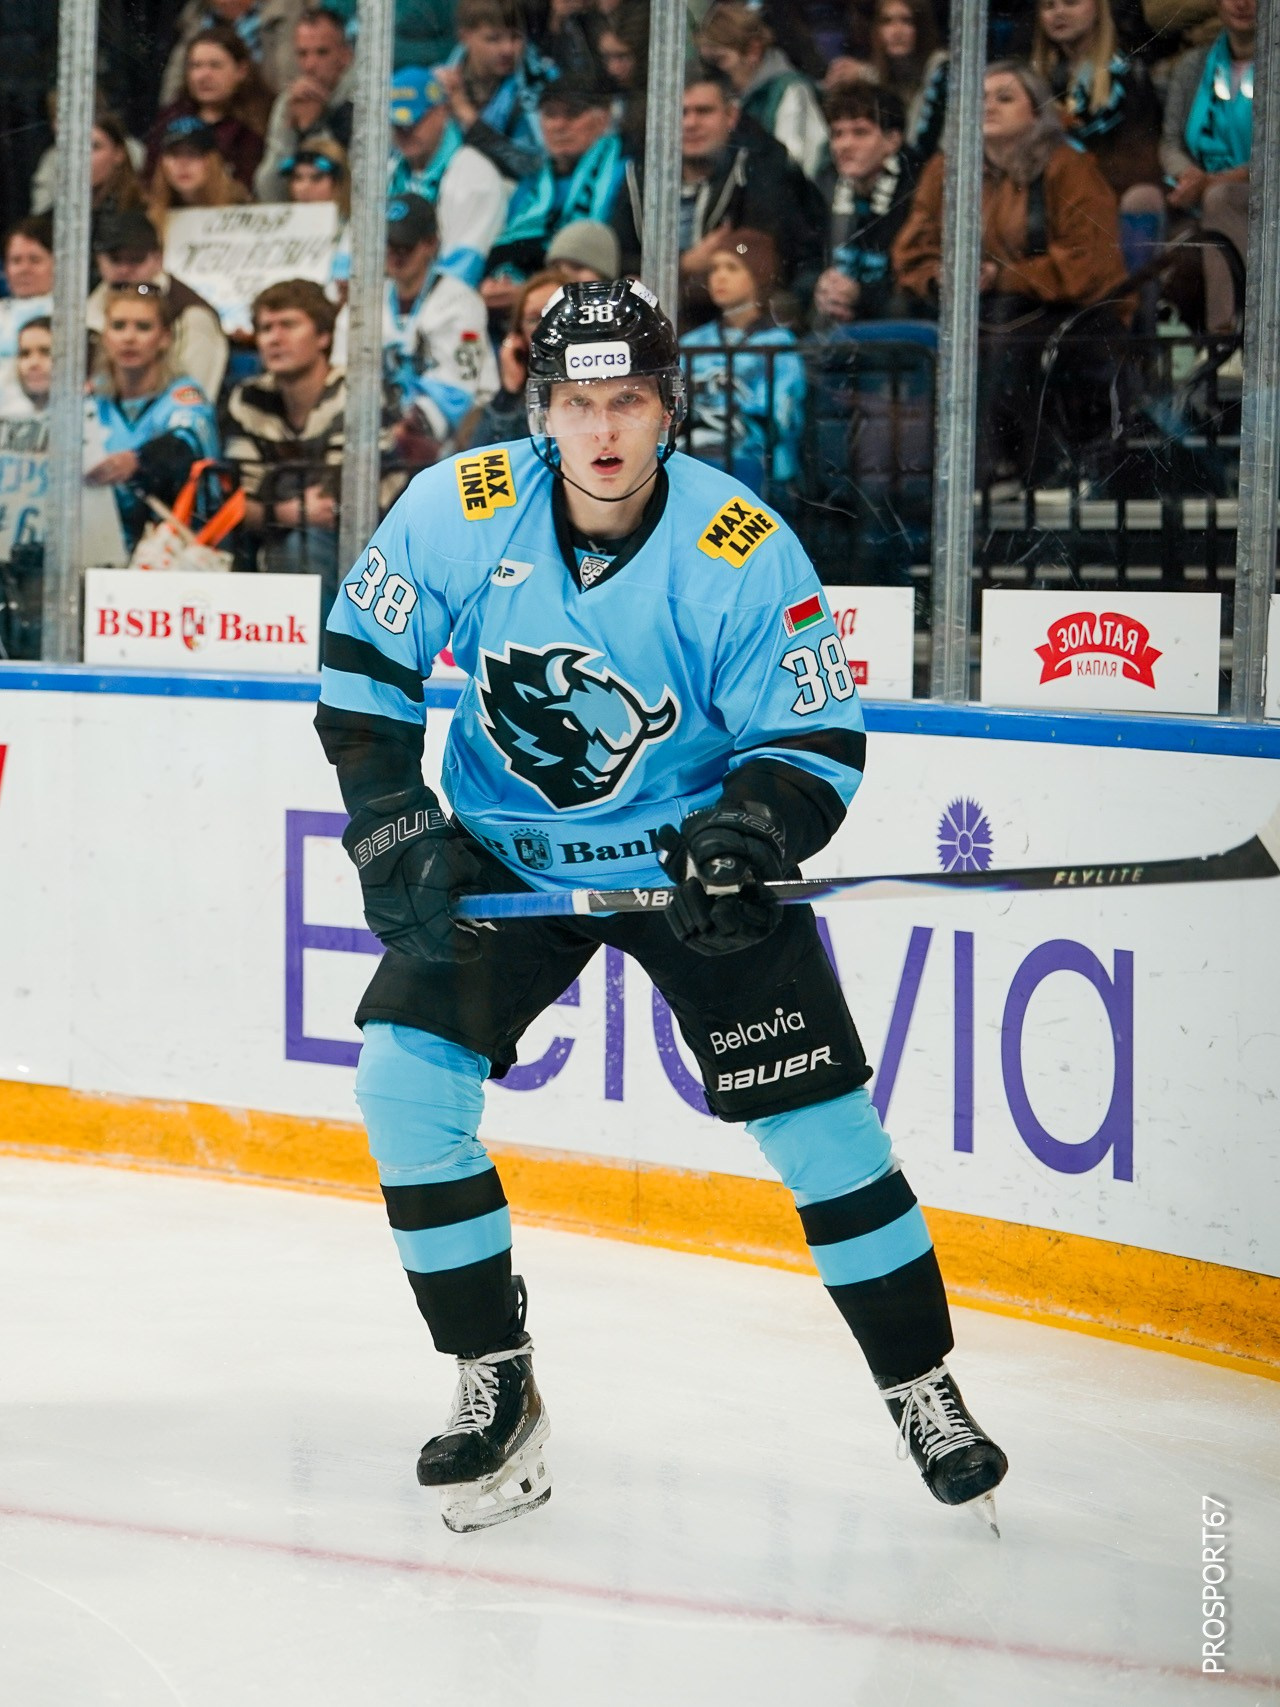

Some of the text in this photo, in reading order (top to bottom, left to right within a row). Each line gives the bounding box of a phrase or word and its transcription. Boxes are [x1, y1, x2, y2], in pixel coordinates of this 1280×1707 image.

[578, 304, 614, 324] 38
[460, 463, 487, 510] LINE
[483, 454, 510, 498] MAX
[705, 502, 752, 549] MAX
[728, 513, 773, 557] LINE
[344, 546, 419, 635] 38
[97, 607, 308, 644] BSB Bank
[1056, 620, 1139, 656] ЗОЛОТАЯ
[779, 633, 856, 717] 38
[1076, 659, 1118, 678] КАПЛЯ
[354, 808, 451, 870] BAUE
[1052, 866, 1144, 886] FLYLITE
[709, 1007, 806, 1055] Belavia
[717, 1045, 842, 1092] BAUER
